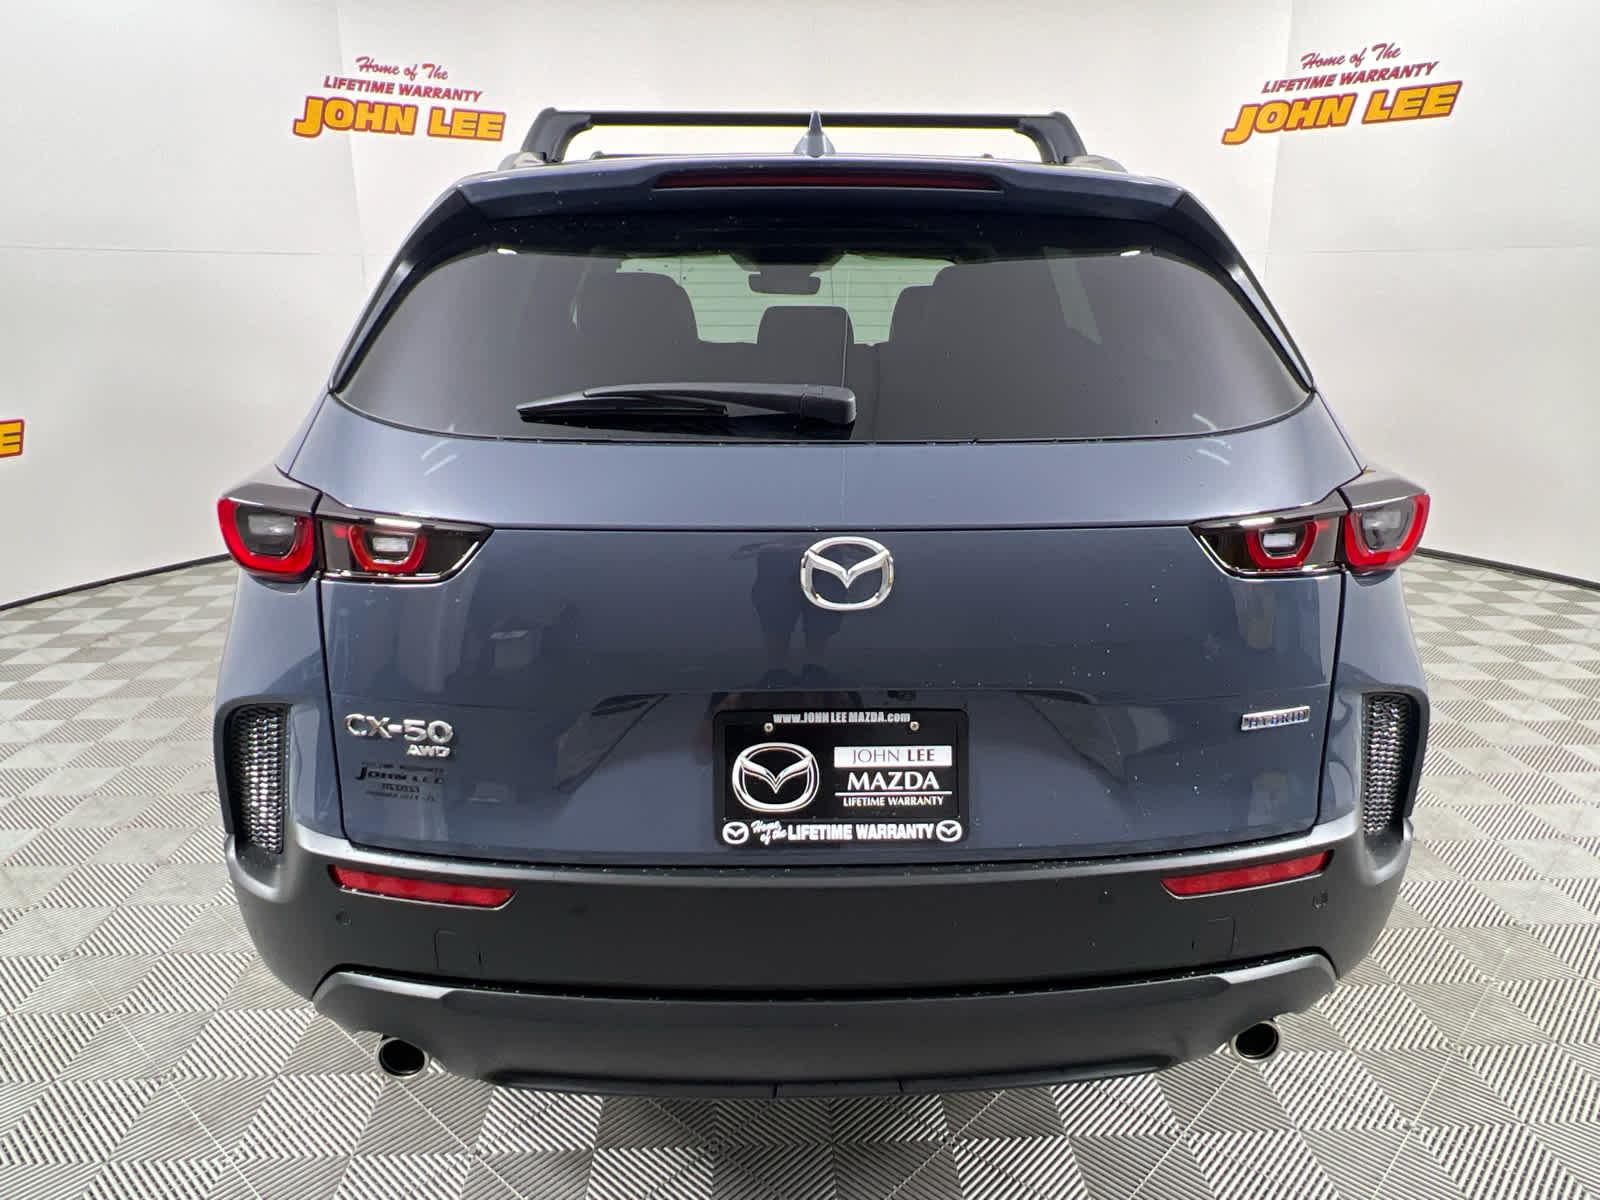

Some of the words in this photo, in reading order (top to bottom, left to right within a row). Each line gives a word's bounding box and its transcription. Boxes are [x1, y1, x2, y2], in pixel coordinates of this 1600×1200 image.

[355, 56, 400, 76] Home
[403, 64, 418, 81] of
[422, 63, 448, 80] The
[1300, 52, 1345, 70] Home
[1349, 48, 1367, 68] of
[1371, 42, 1401, 61] The
[323, 75, 395, 95] LIFETIME
[399, 83, 483, 102] WARRANTY
[1261, 73, 1338, 94] LIFETIME
[1339, 61, 1440, 86] WARRANTY
[292, 95, 419, 138] JOHN
[427, 106, 507, 142] LEE
[1221, 92, 1358, 145] JOHN
[1361, 80, 1463, 125] LEE
[343, 713, 454, 743] CX-50
[831, 712, 847, 723] LEE
[406, 744, 451, 757] AWD
[852, 748, 900, 764] JOHN
[907, 748, 935, 762] LEE
[847, 771, 940, 791] MAZDA
[843, 796, 886, 807] LIFETIME
[888, 796, 944, 806] WARRANTY
[787, 824, 853, 840] LIFETIME
[855, 823, 934, 840] WARRANTY
